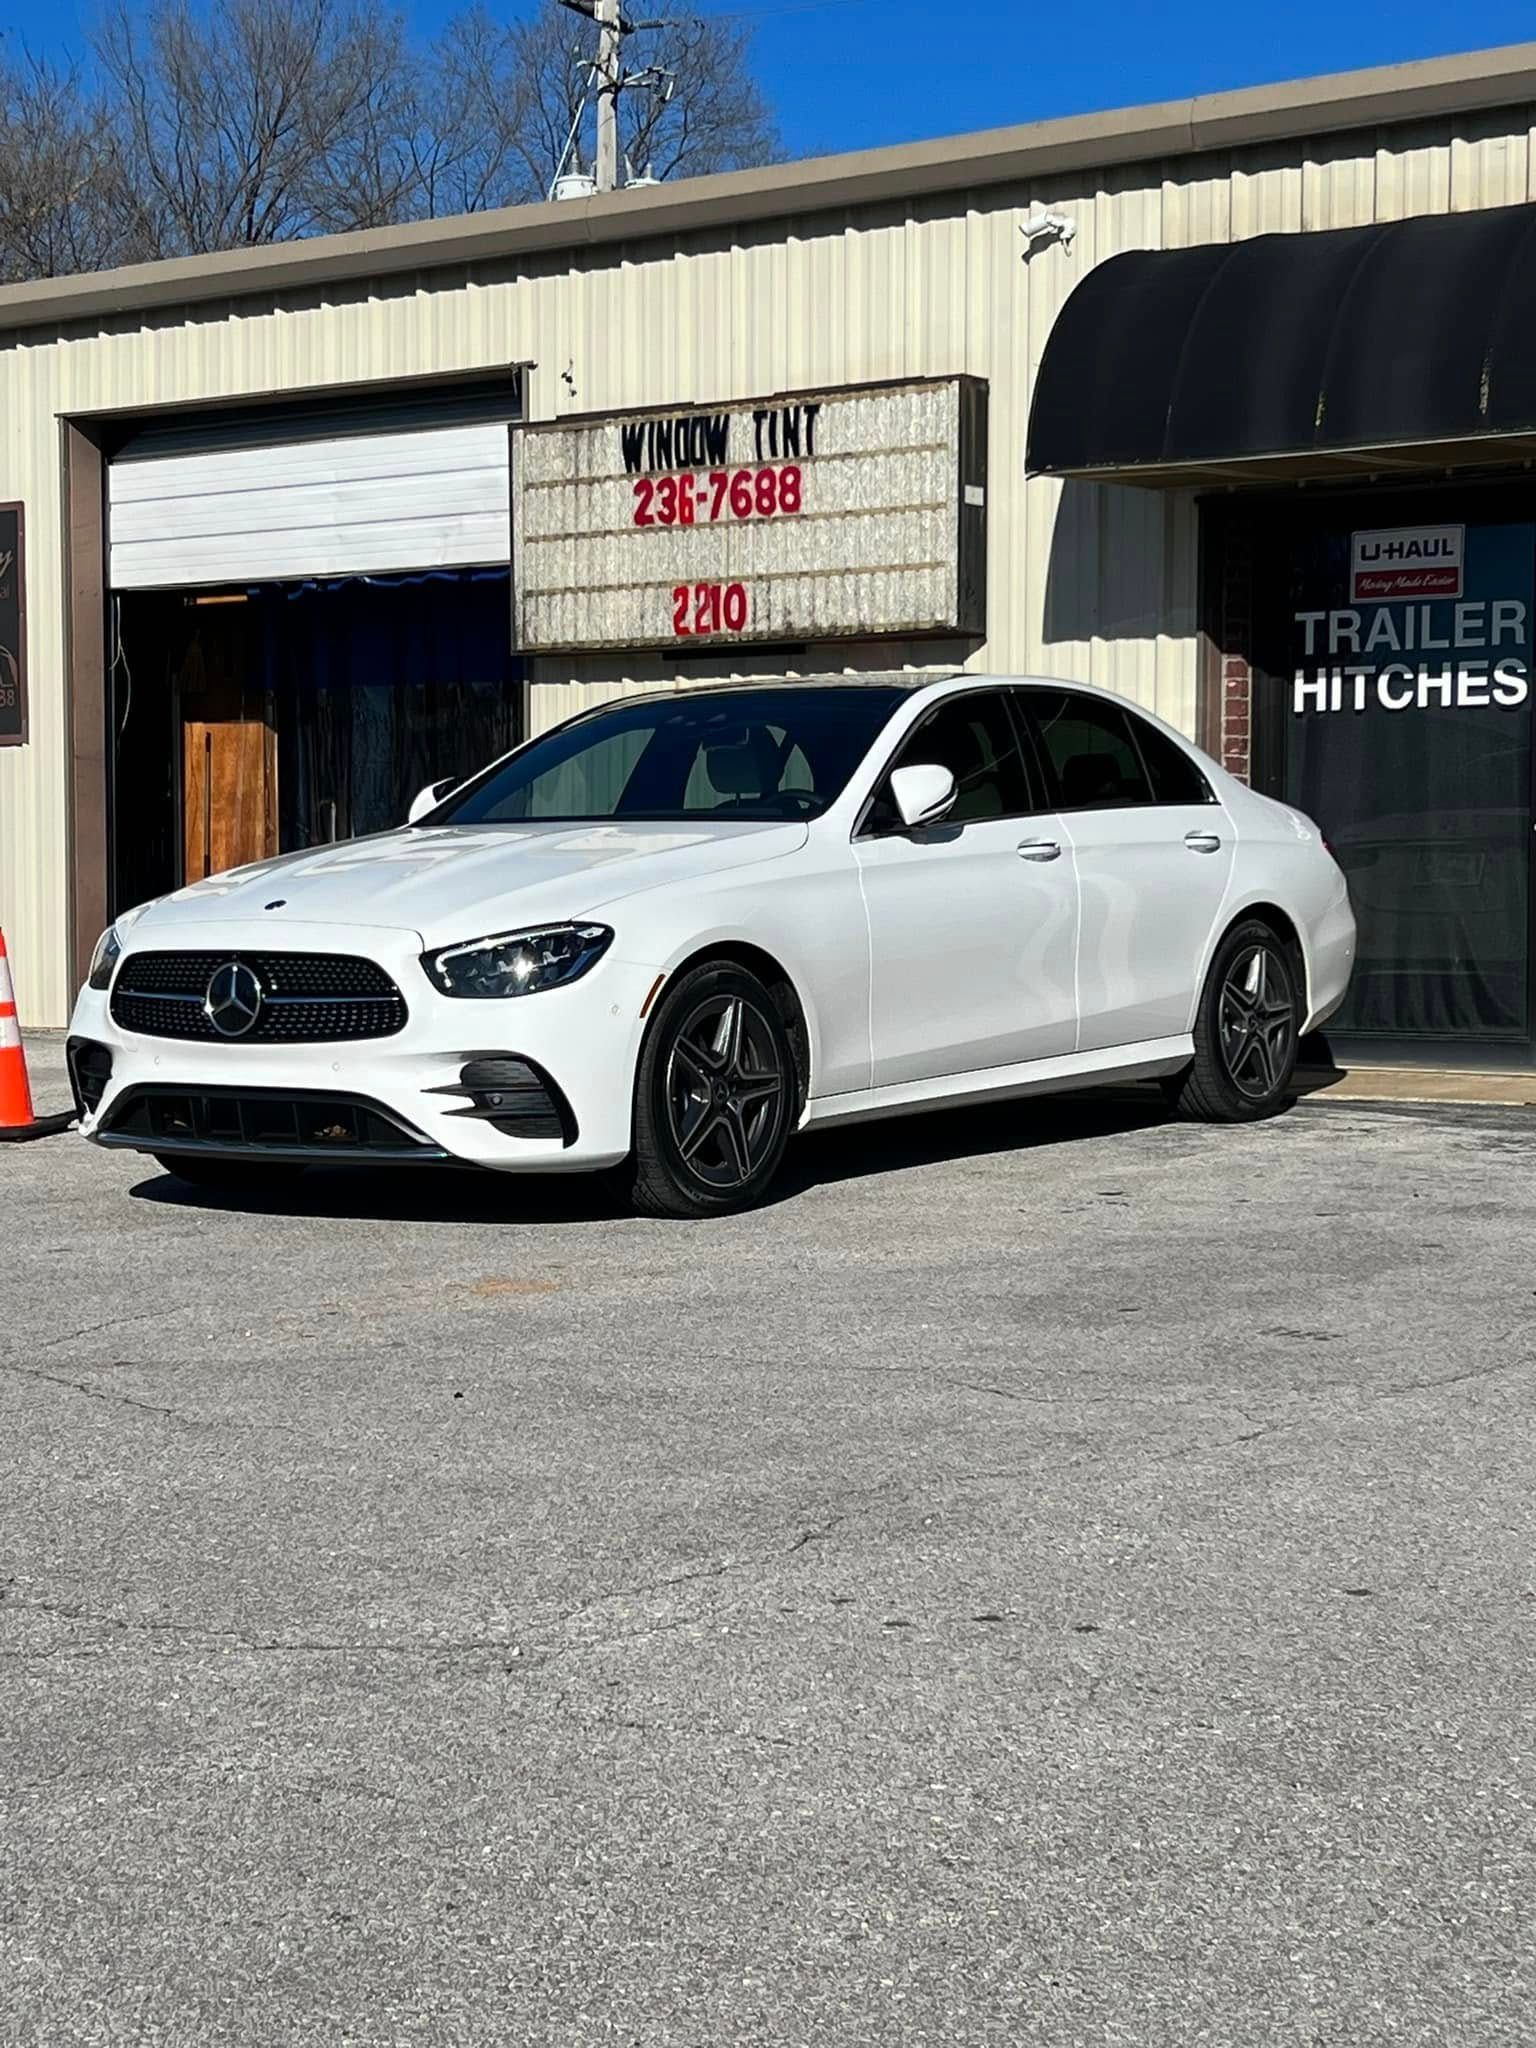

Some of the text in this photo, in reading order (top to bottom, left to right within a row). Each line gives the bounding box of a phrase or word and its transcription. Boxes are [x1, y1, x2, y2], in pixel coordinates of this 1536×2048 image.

[621, 404, 821, 473] WINDOW TINT
[633, 465, 802, 526] 236-7688
[1360, 538, 1455, 561] U-HAUL
[673, 582, 748, 636] 2210
[1359, 578, 1393, 592] Moving
[1393, 575, 1421, 588] Made
[1295, 600, 1527, 656] TRAILER
[1293, 657, 1529, 713] HITCHES
